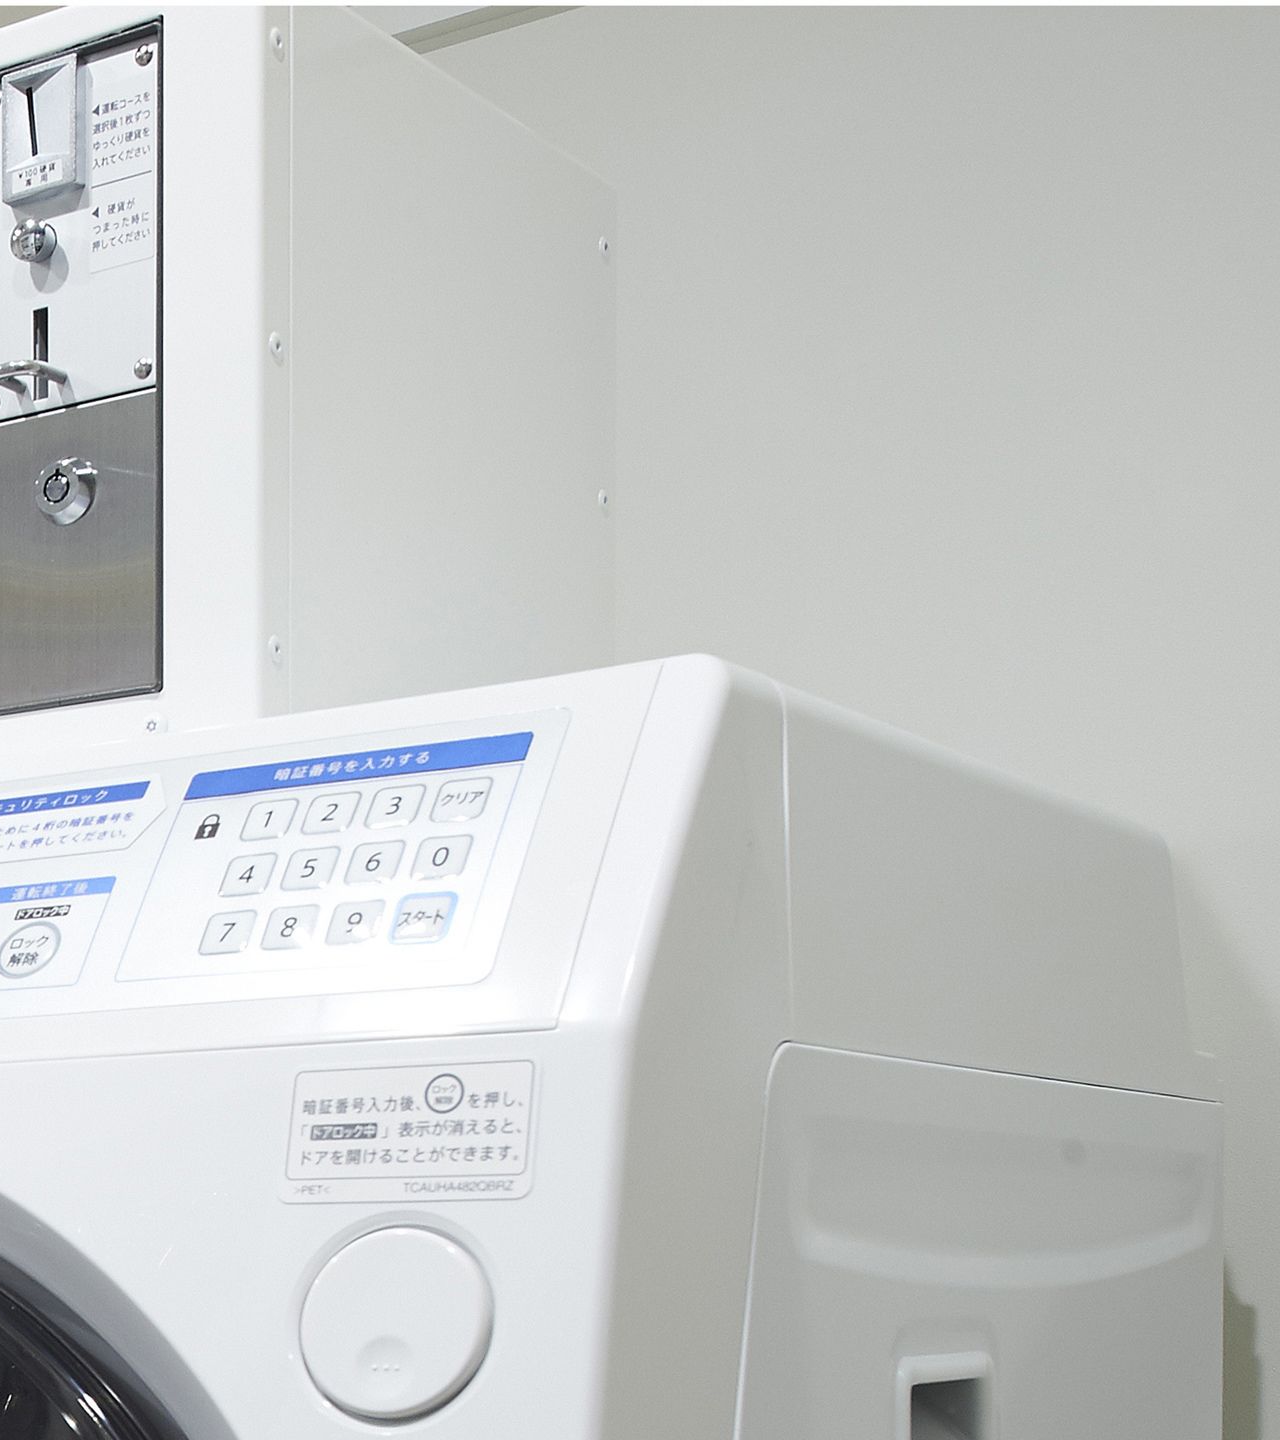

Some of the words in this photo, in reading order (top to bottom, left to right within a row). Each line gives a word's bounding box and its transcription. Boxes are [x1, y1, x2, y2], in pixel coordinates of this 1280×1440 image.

[92, 126, 150, 151] ゆっくり硬貨を
[92, 145, 150, 170] 入れてください
[107, 198, 135, 214] 硬貨が
[93, 212, 149, 234] つまった時に
[92, 228, 150, 252] 押してください
[274, 752, 431, 782] 暗証番号を入力する
[263, 811, 274, 828] 1
[321, 803, 339, 822] 2
[386, 796, 403, 815] 3
[441, 790, 484, 807] クリア
[239, 865, 255, 883] 4
[300, 858, 319, 878] 5
[364, 852, 382, 871] 6
[11, 881, 88, 901] 運転終了後
[220, 922, 236, 942] 7
[280, 917, 297, 938] 8
[397, 909, 445, 927] スタート
[10, 936, 49, 950] ロック
[6, 953, 39, 967] 解除
[301, 1146, 519, 1165] ドアを開けることができます。
